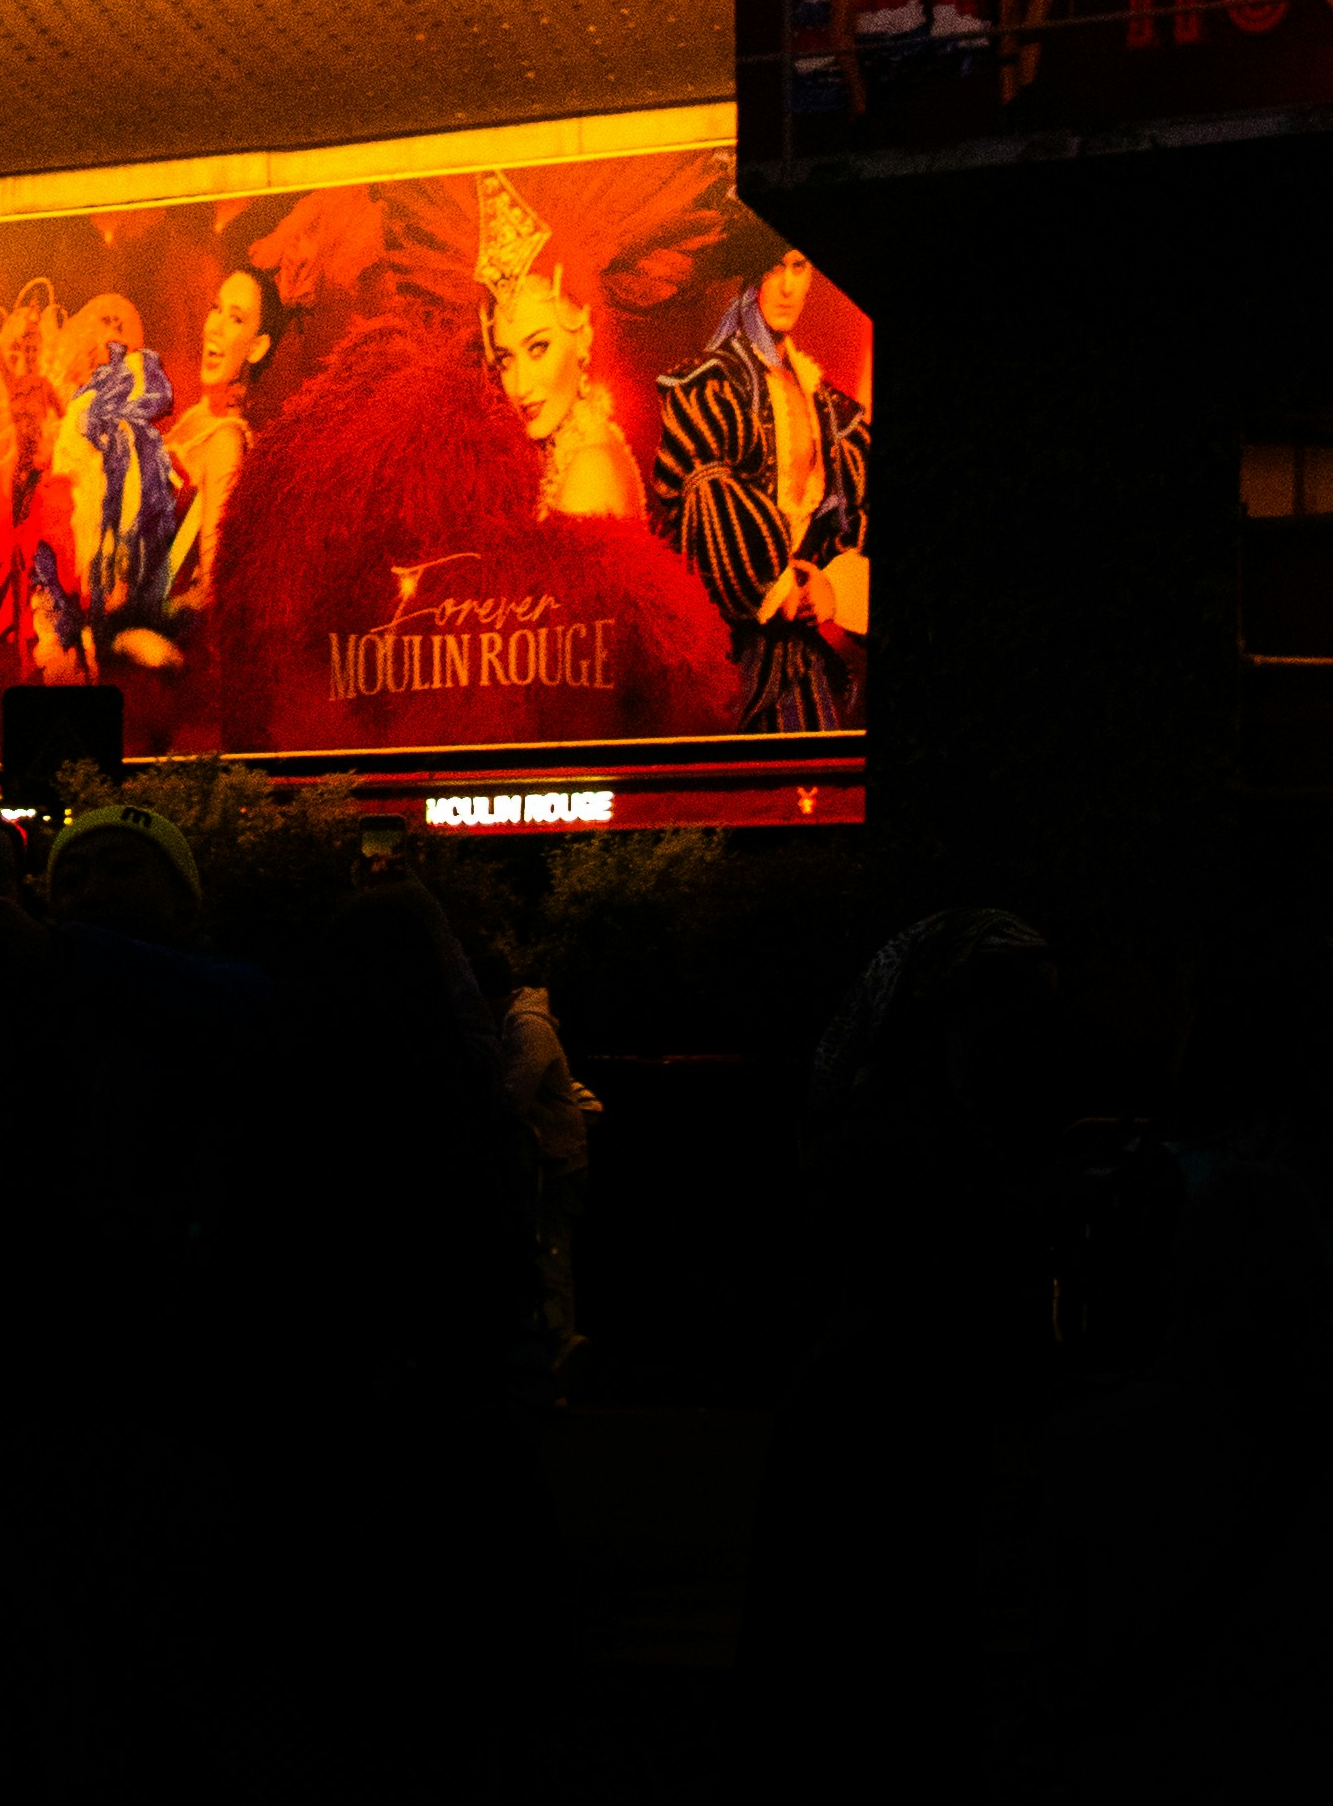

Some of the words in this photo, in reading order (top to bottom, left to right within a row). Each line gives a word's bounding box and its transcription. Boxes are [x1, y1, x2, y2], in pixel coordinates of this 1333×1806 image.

[370, 552, 562, 631] Forever
[328, 632, 471, 702] MOULIN
[479, 618, 616, 690] ROUGE
[426, 796, 522, 826] MOULIN
[524, 790, 615, 823] ROUGE
